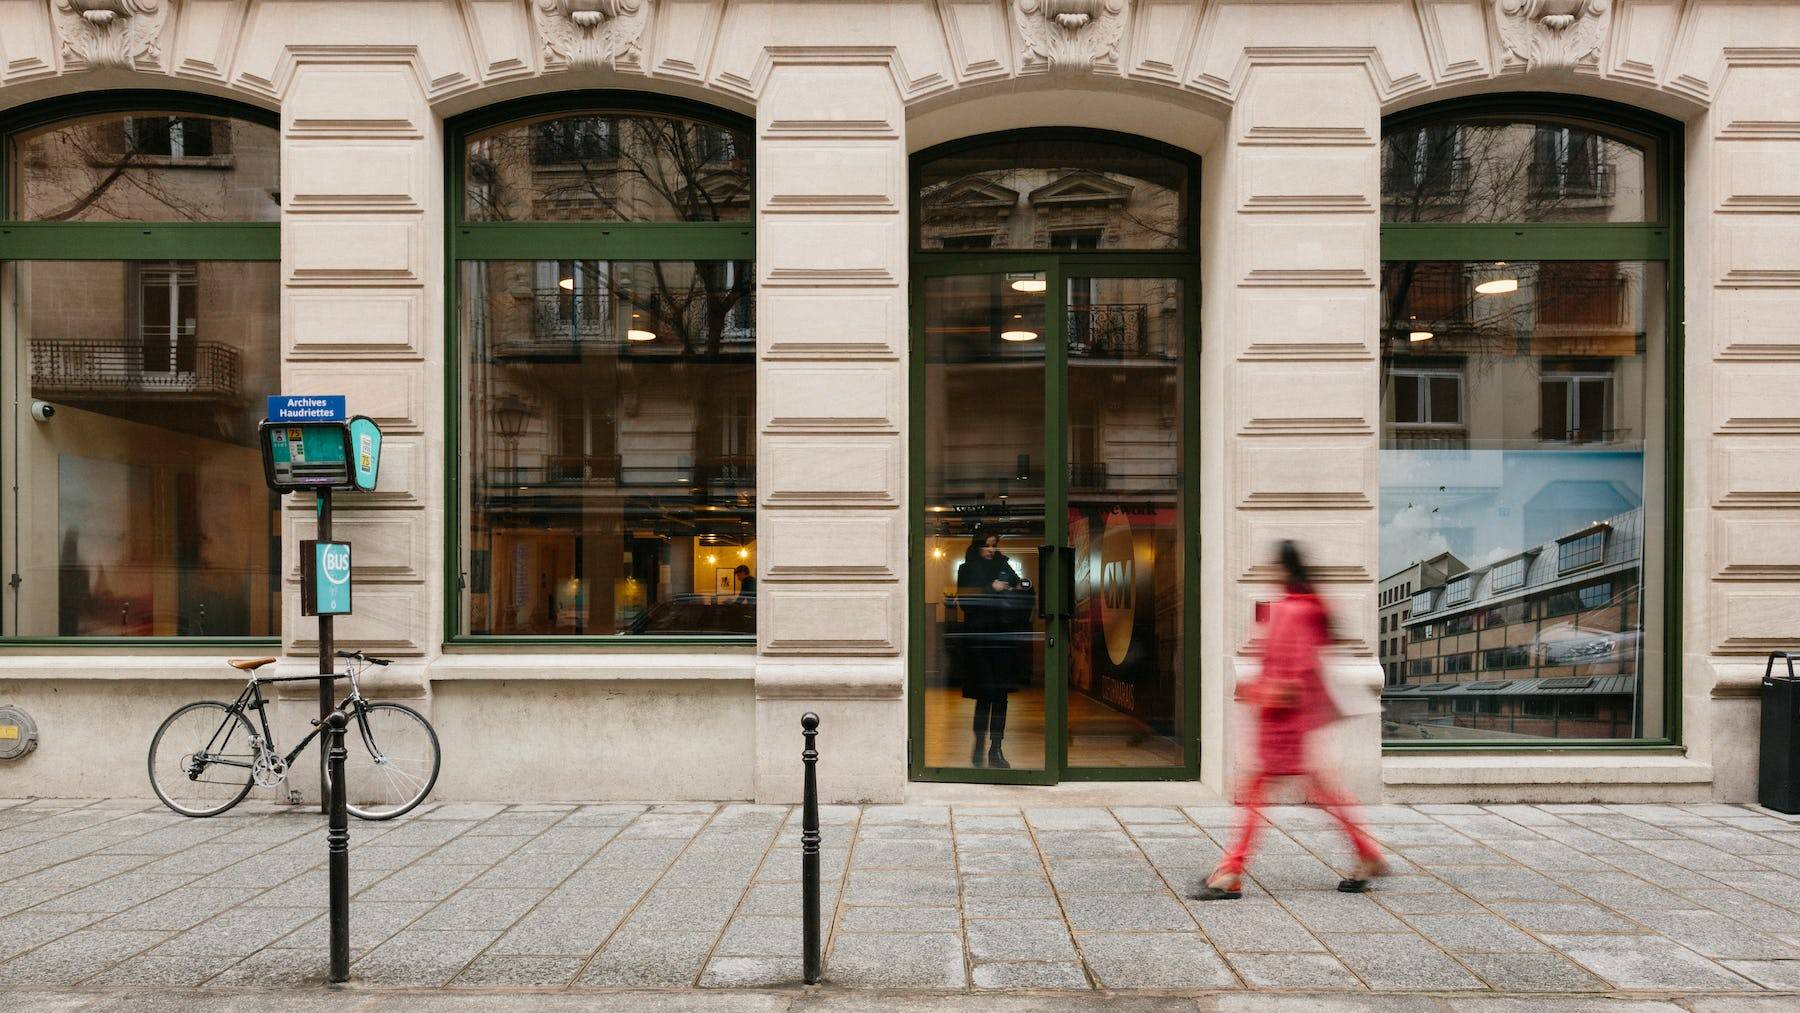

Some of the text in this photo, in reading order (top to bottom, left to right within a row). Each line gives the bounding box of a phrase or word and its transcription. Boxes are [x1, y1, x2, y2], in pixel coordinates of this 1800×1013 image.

[287, 398, 327, 407] Archives
[280, 408, 334, 418] Haudriettes
[327, 553, 349, 571] BUS
